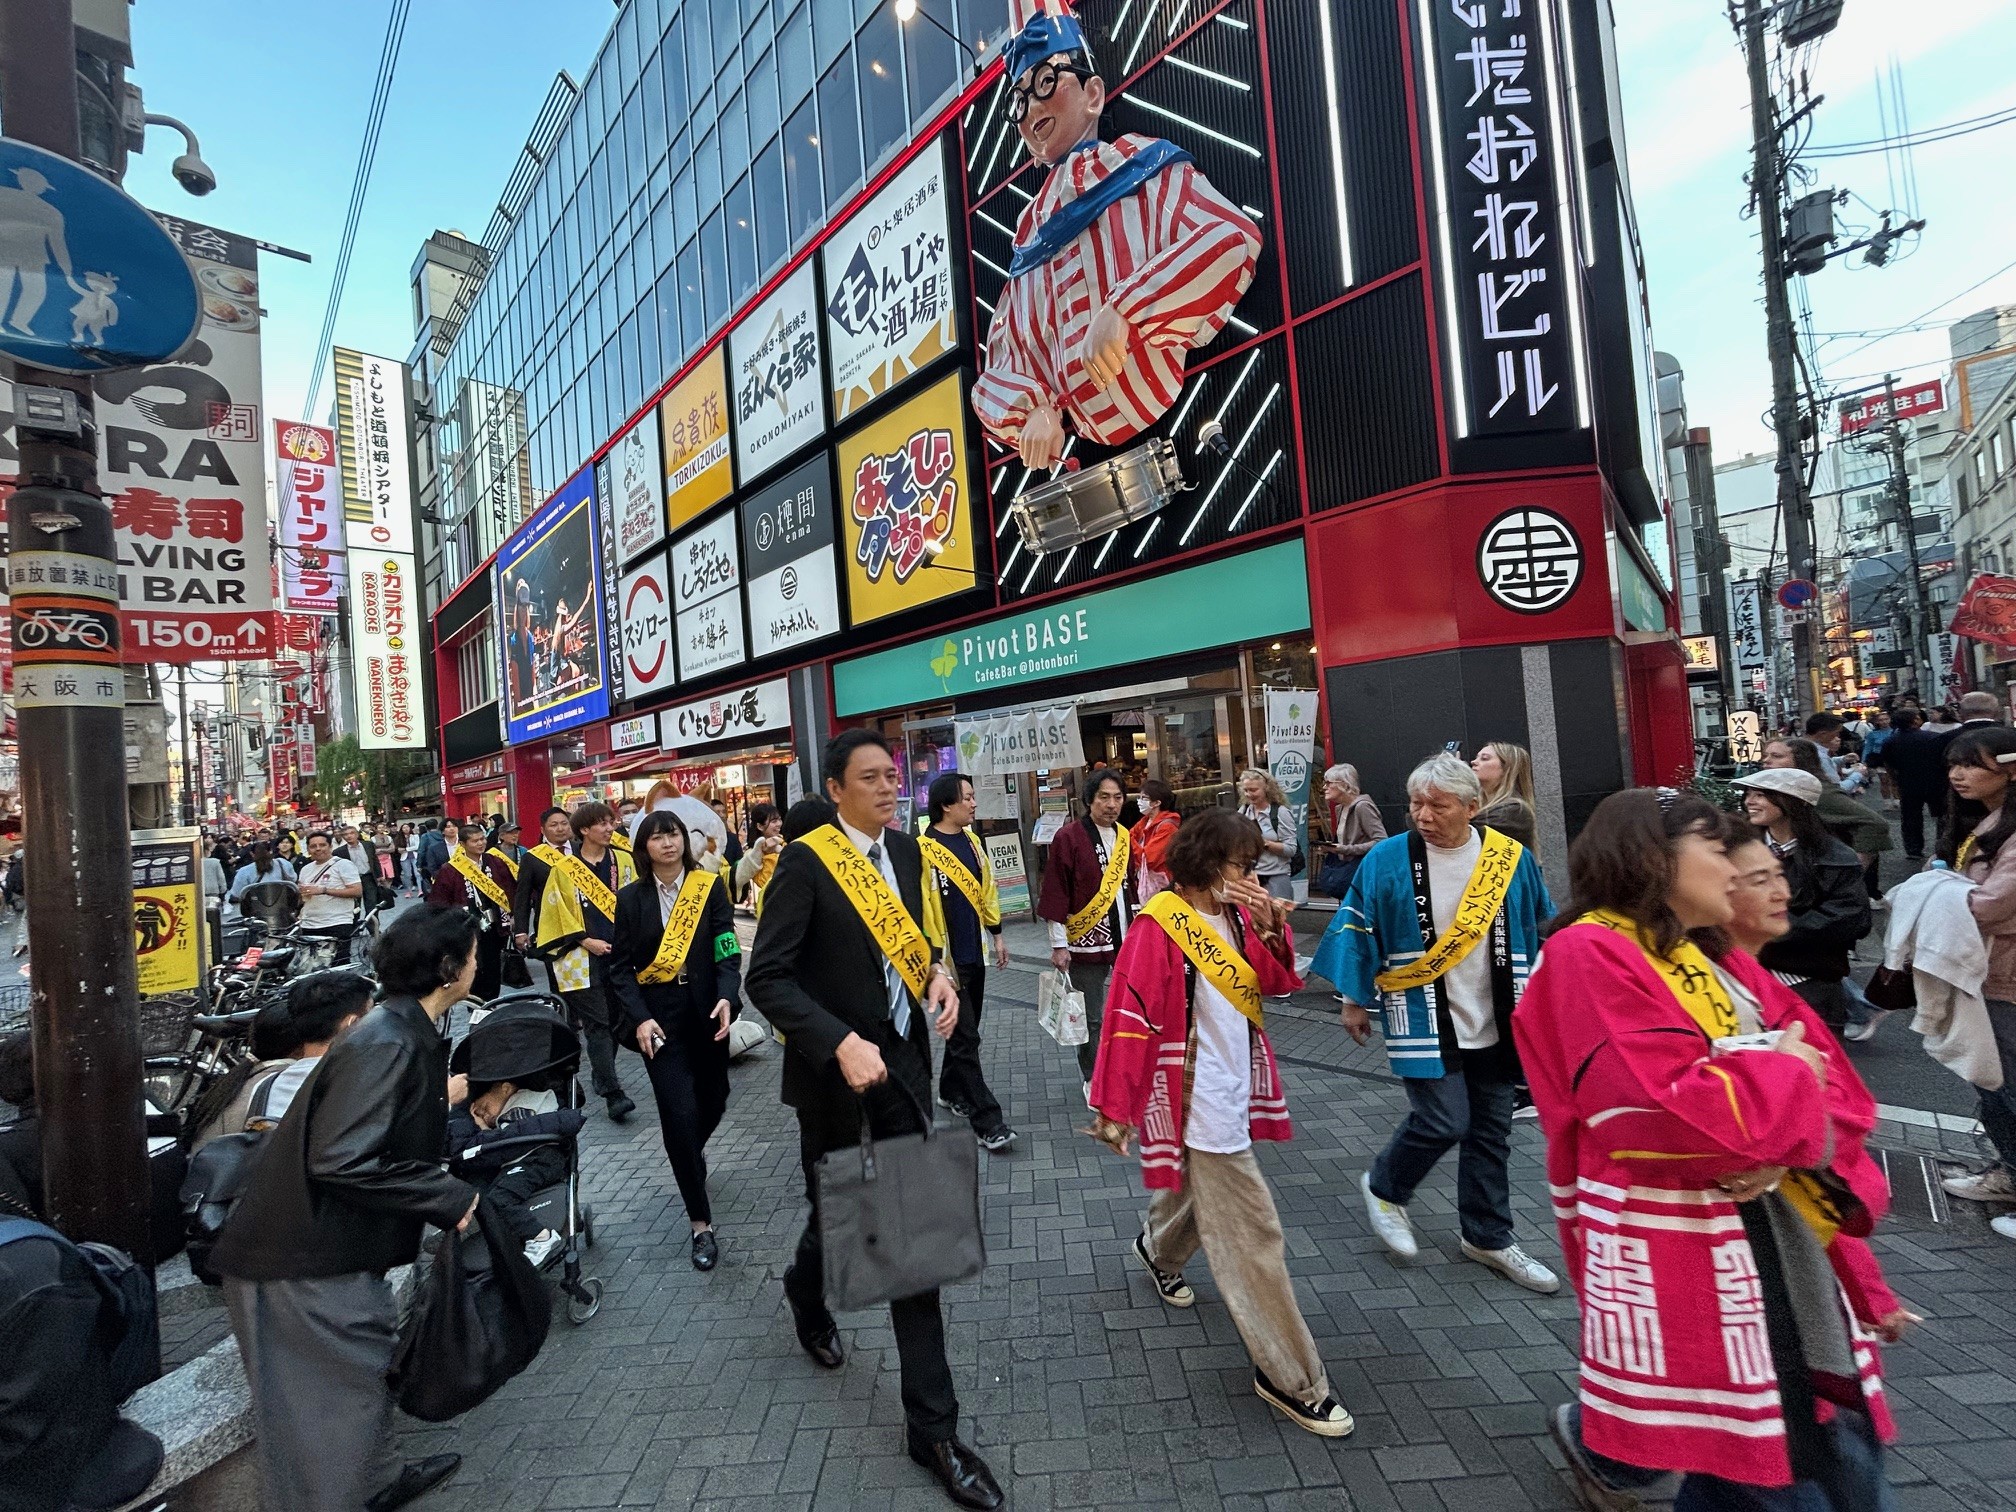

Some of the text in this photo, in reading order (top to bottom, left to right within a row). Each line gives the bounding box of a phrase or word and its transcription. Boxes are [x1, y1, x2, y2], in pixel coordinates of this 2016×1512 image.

[882, 174, 939, 238] 大衆居酒屋
[939, 267, 949, 312] だしや
[882, 273, 937, 348] 酒場
[738, 330, 817, 426] ぼんくら家
[370, 363, 391, 519] よしもと道頓堀シアター
[750, 401, 815, 453] OKONOMIYAKI
[674, 441, 722, 489] TORIKIZOKU
[785, 523, 811, 544] enma
[143, 576, 247, 604] BAR
[363, 572, 380, 635] KARAOKE
[383, 573, 405, 636] カラオケ
[130, 618, 236, 648] 150m
[238, 646, 267, 655] ahead
[625, 613, 669, 651] スシロー
[963, 609, 1088, 666] Pivot BASE
[975, 650, 1079, 684] Cafe&Bar @Dotonbori
[20, 679, 115, 699] 大阪市
[368, 656, 387, 737] MANEKINEKO
[620, 731, 645, 746] PARLOR
[983, 725, 1069, 753] Pivot BASE
[1271, 725, 1291, 737] Pivot
[1278, 766, 1305, 776] VEGAN
[1283, 756, 1299, 766] ALL
[991, 844, 1018, 858] VEGAN
[995, 857, 1019, 870] CAFE
[827, 834, 918, 947] すきやねんミナミ
[1414, 862, 1434, 943] Bar マスダ
[662, 882, 708, 975] すきやねんミナミ
